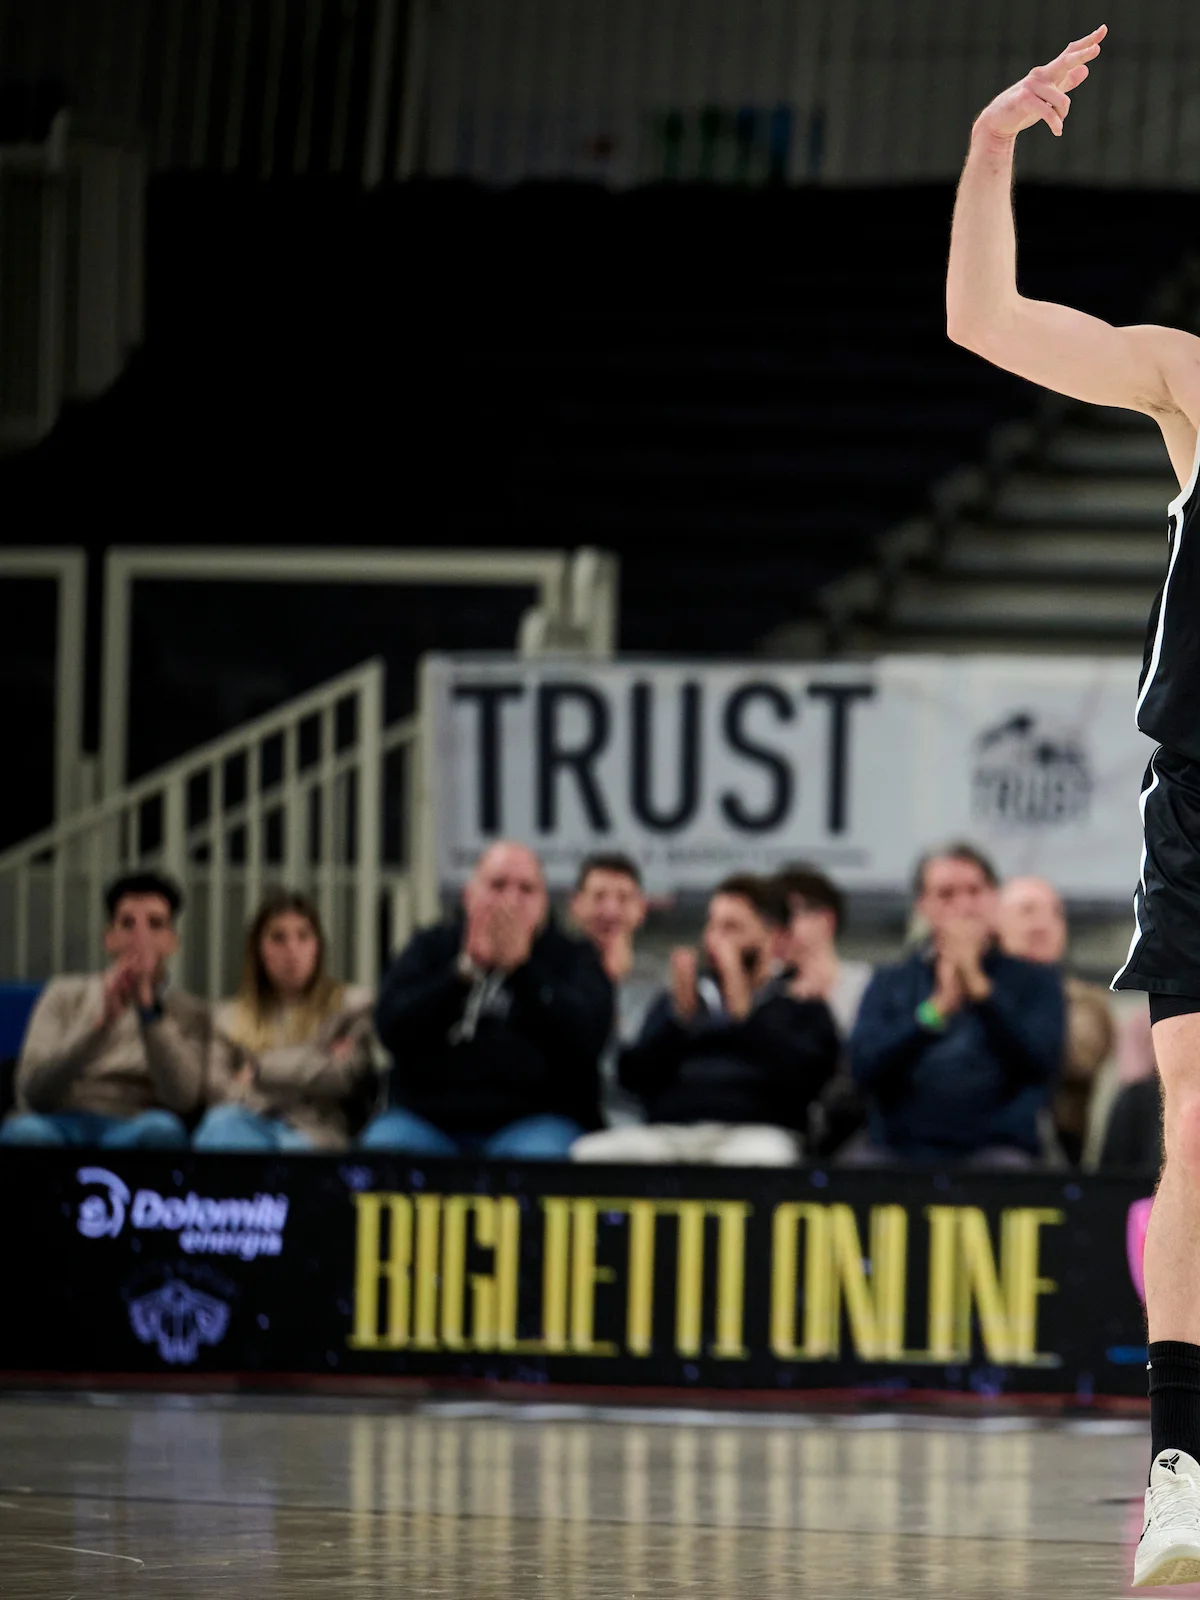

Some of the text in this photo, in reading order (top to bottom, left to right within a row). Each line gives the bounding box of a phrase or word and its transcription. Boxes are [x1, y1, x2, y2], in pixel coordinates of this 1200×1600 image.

[452, 681, 875, 834] TRUST
[129, 1188, 290, 1232] Dolomiti
[349, 1191, 1063, 1367] BIGLIETTI ONLINE
